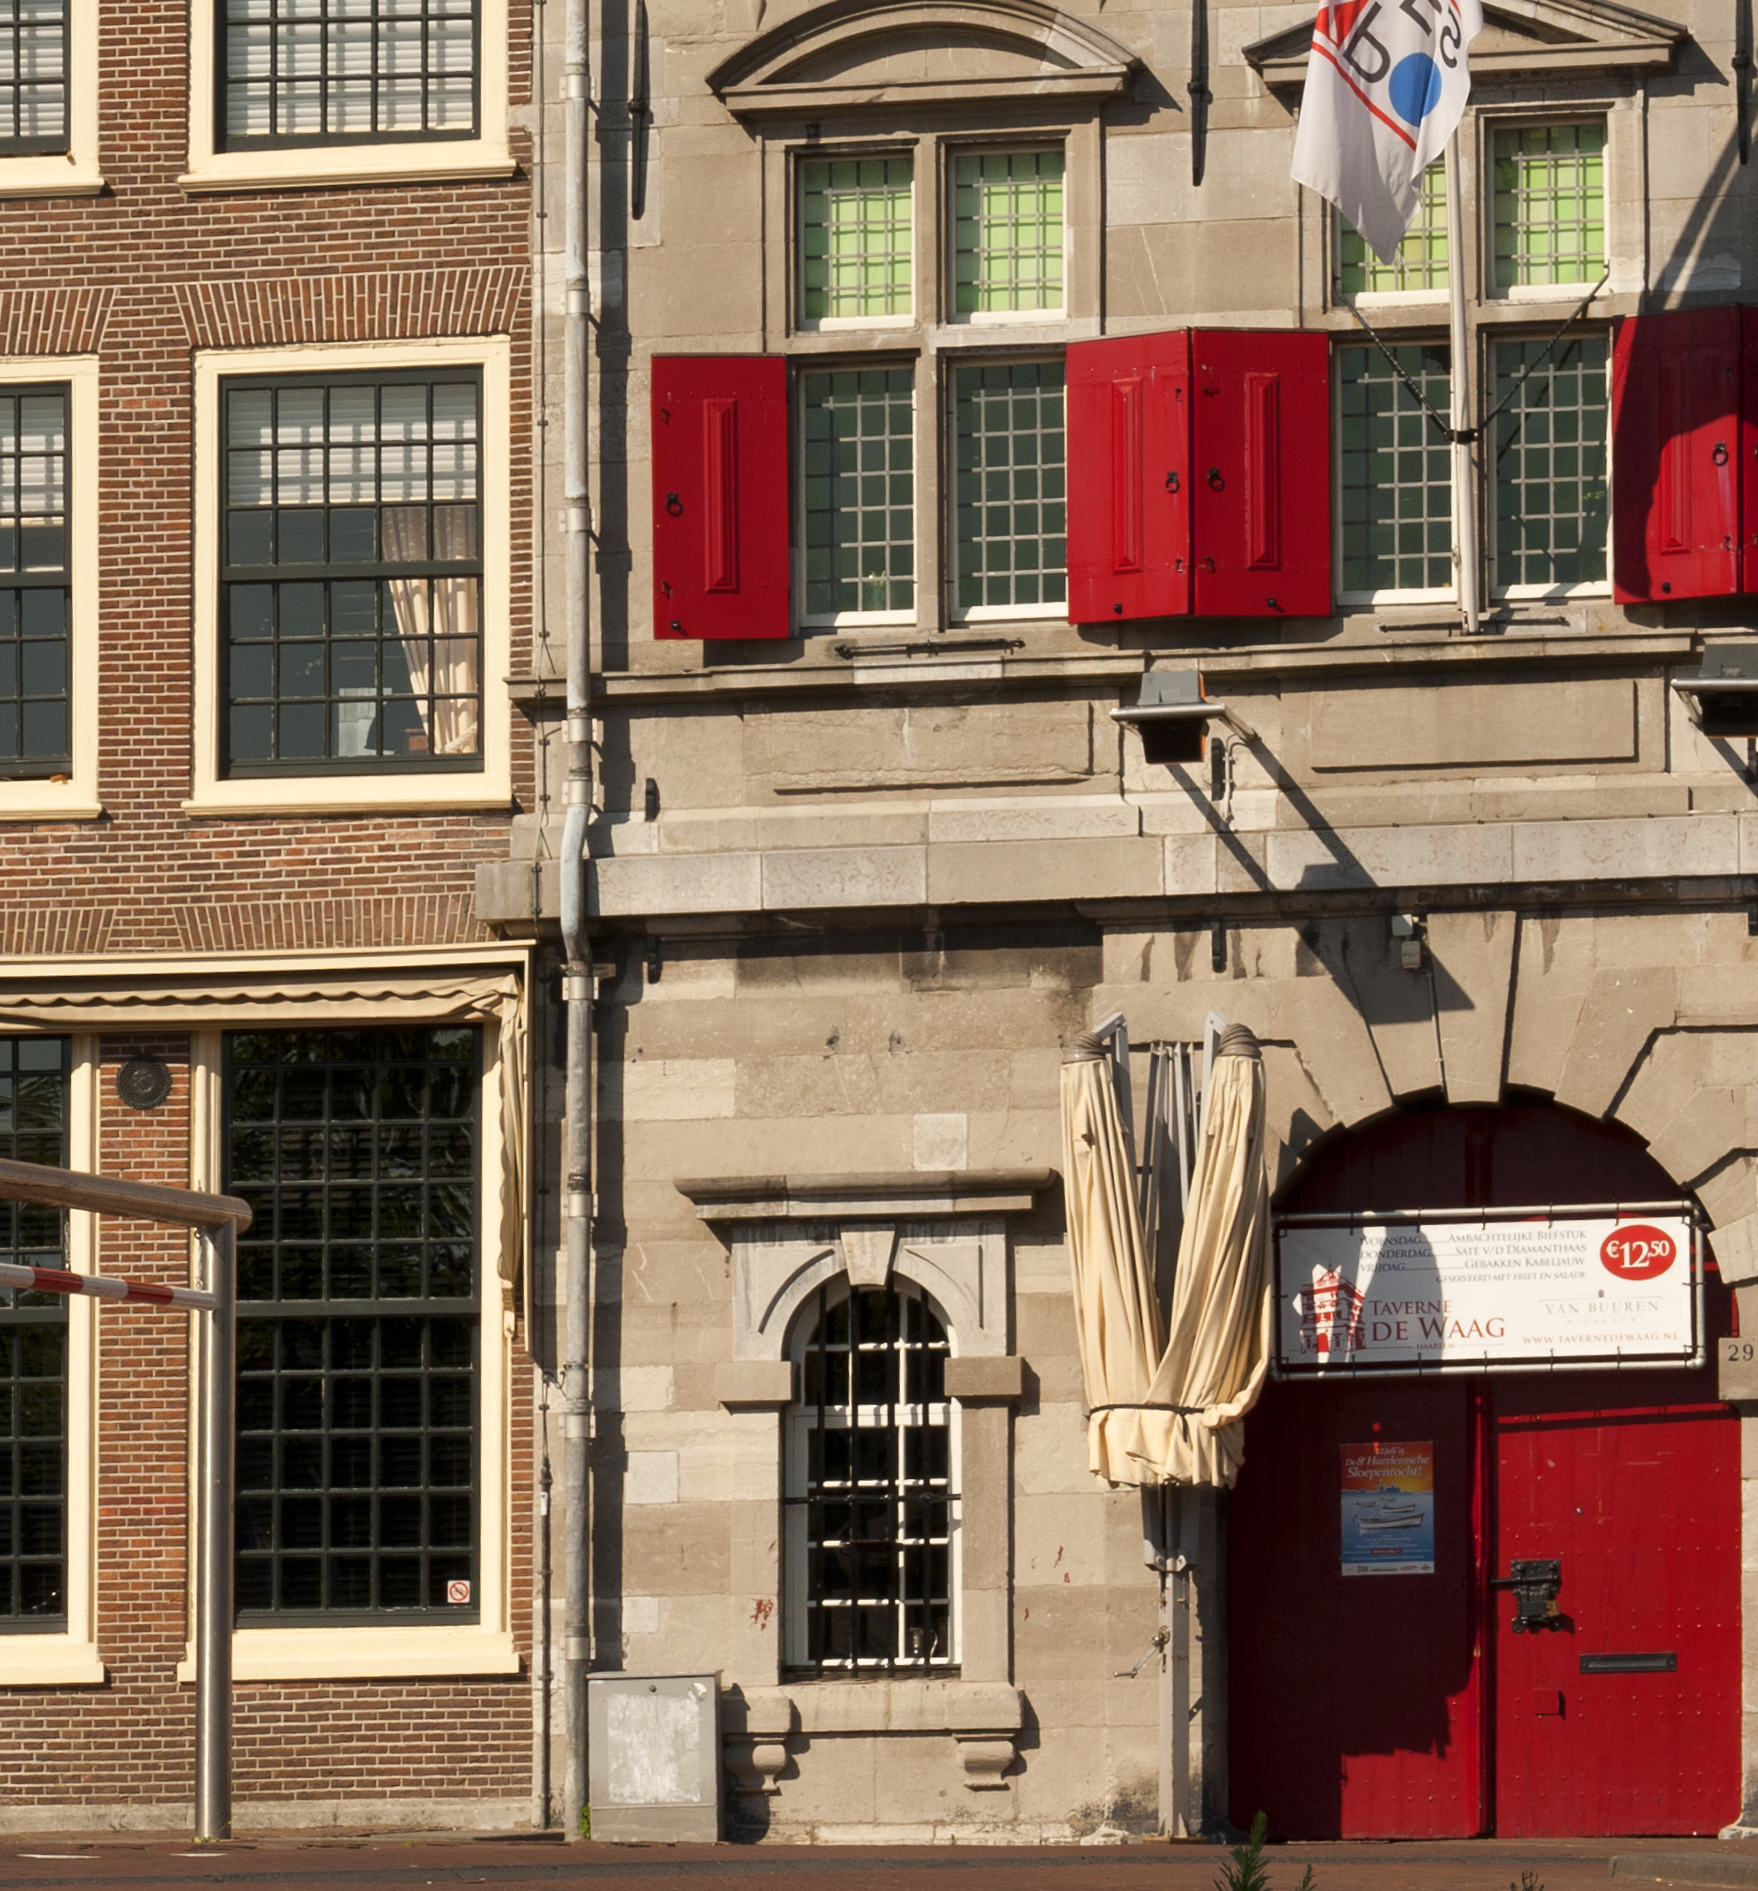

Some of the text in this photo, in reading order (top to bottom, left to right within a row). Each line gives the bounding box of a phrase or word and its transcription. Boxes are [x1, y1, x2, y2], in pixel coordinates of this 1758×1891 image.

[1447, 1230, 1534, 1244] AMBACHTELIJKE
[1537, 1229, 1587, 1241] BIEFSTUK
[1361, 1249, 1432, 1259] DONDERDAG
[1483, 1245, 1504, 1256] V/D
[1506, 1243, 1587, 1255] DIAMANTHAAS
[1360, 1256, 1585, 1273] VRIJDAG GEBAKKEN KABELJAUW
[1436, 1273, 1493, 1284] GESERVEERD
[1493, 1272, 1512, 1282] MET
[1539, 1272, 1552, 1281] EN
[1553, 1270, 1586, 1281] SALADE
[1369, 1299, 1453, 1316] TAVERNE
[1545, 1300, 1660, 1315] VAN BUUREN
[1372, 1316, 1506, 1342] DE WAAG
[1727, 1343, 1754, 1362] 29
